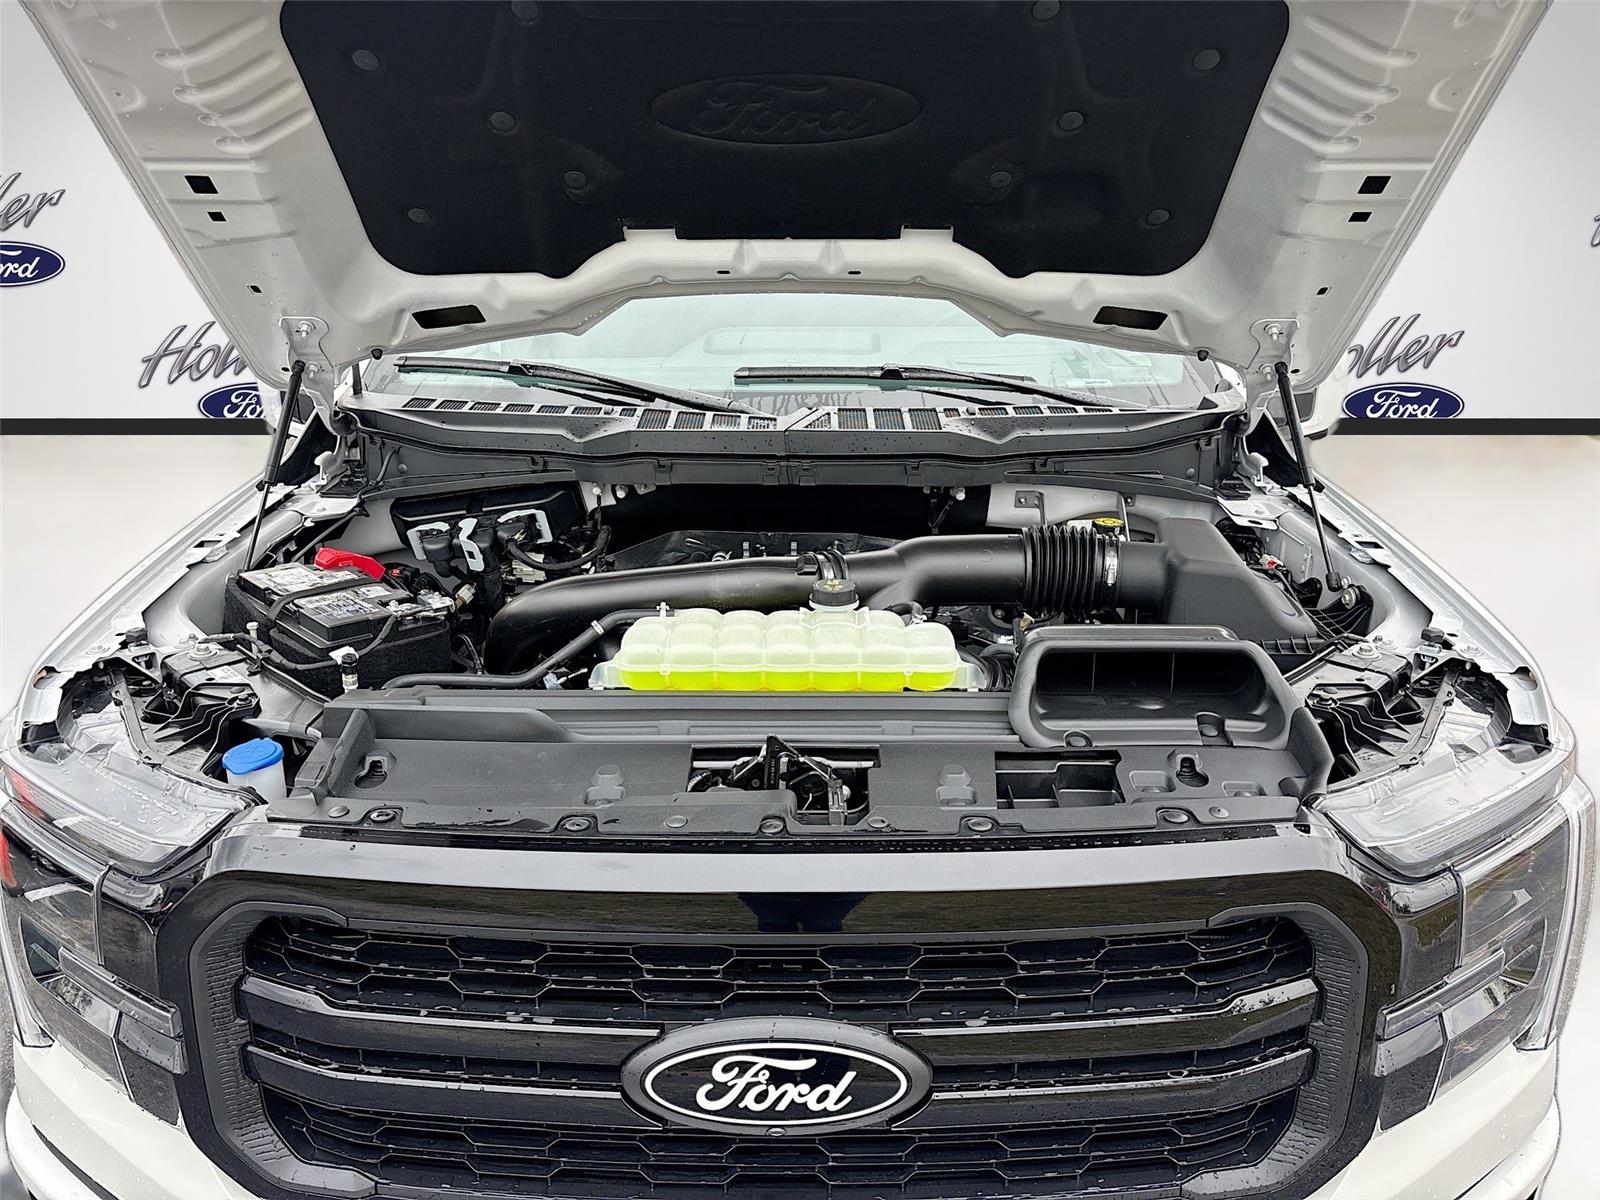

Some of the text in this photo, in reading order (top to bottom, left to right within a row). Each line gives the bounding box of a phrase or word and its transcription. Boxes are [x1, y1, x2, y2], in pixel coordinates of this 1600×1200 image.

[691, 81, 876, 134] Ford
[1366, 390, 1440, 418] Ford
[696, 1055, 857, 1112] Ford
